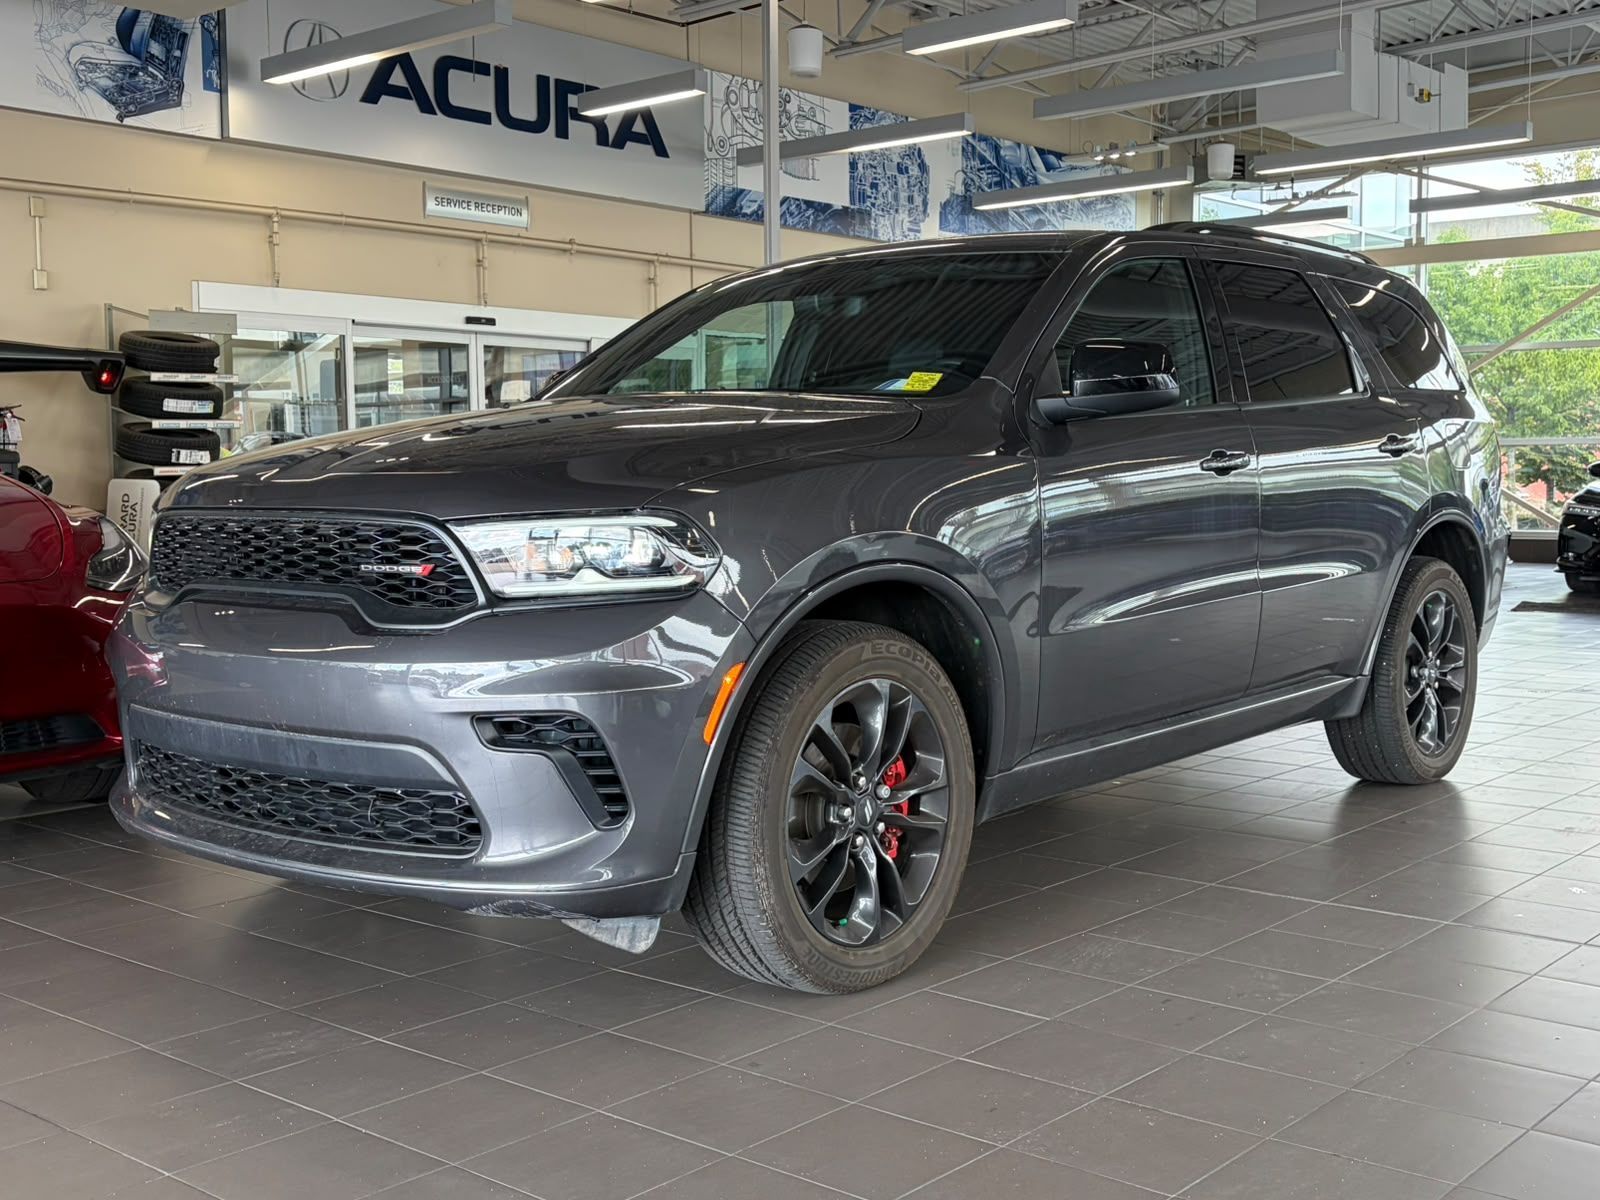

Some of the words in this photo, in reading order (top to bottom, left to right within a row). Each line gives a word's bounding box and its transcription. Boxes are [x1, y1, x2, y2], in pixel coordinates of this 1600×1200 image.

[359, 52, 670, 159] ACURA
[434, 196, 472, 211] SERVICE
[474, 201, 523, 217] RECEPTION
[361, 564, 422, 573] DODGE
[870, 641, 942, 682] ECOPIA
